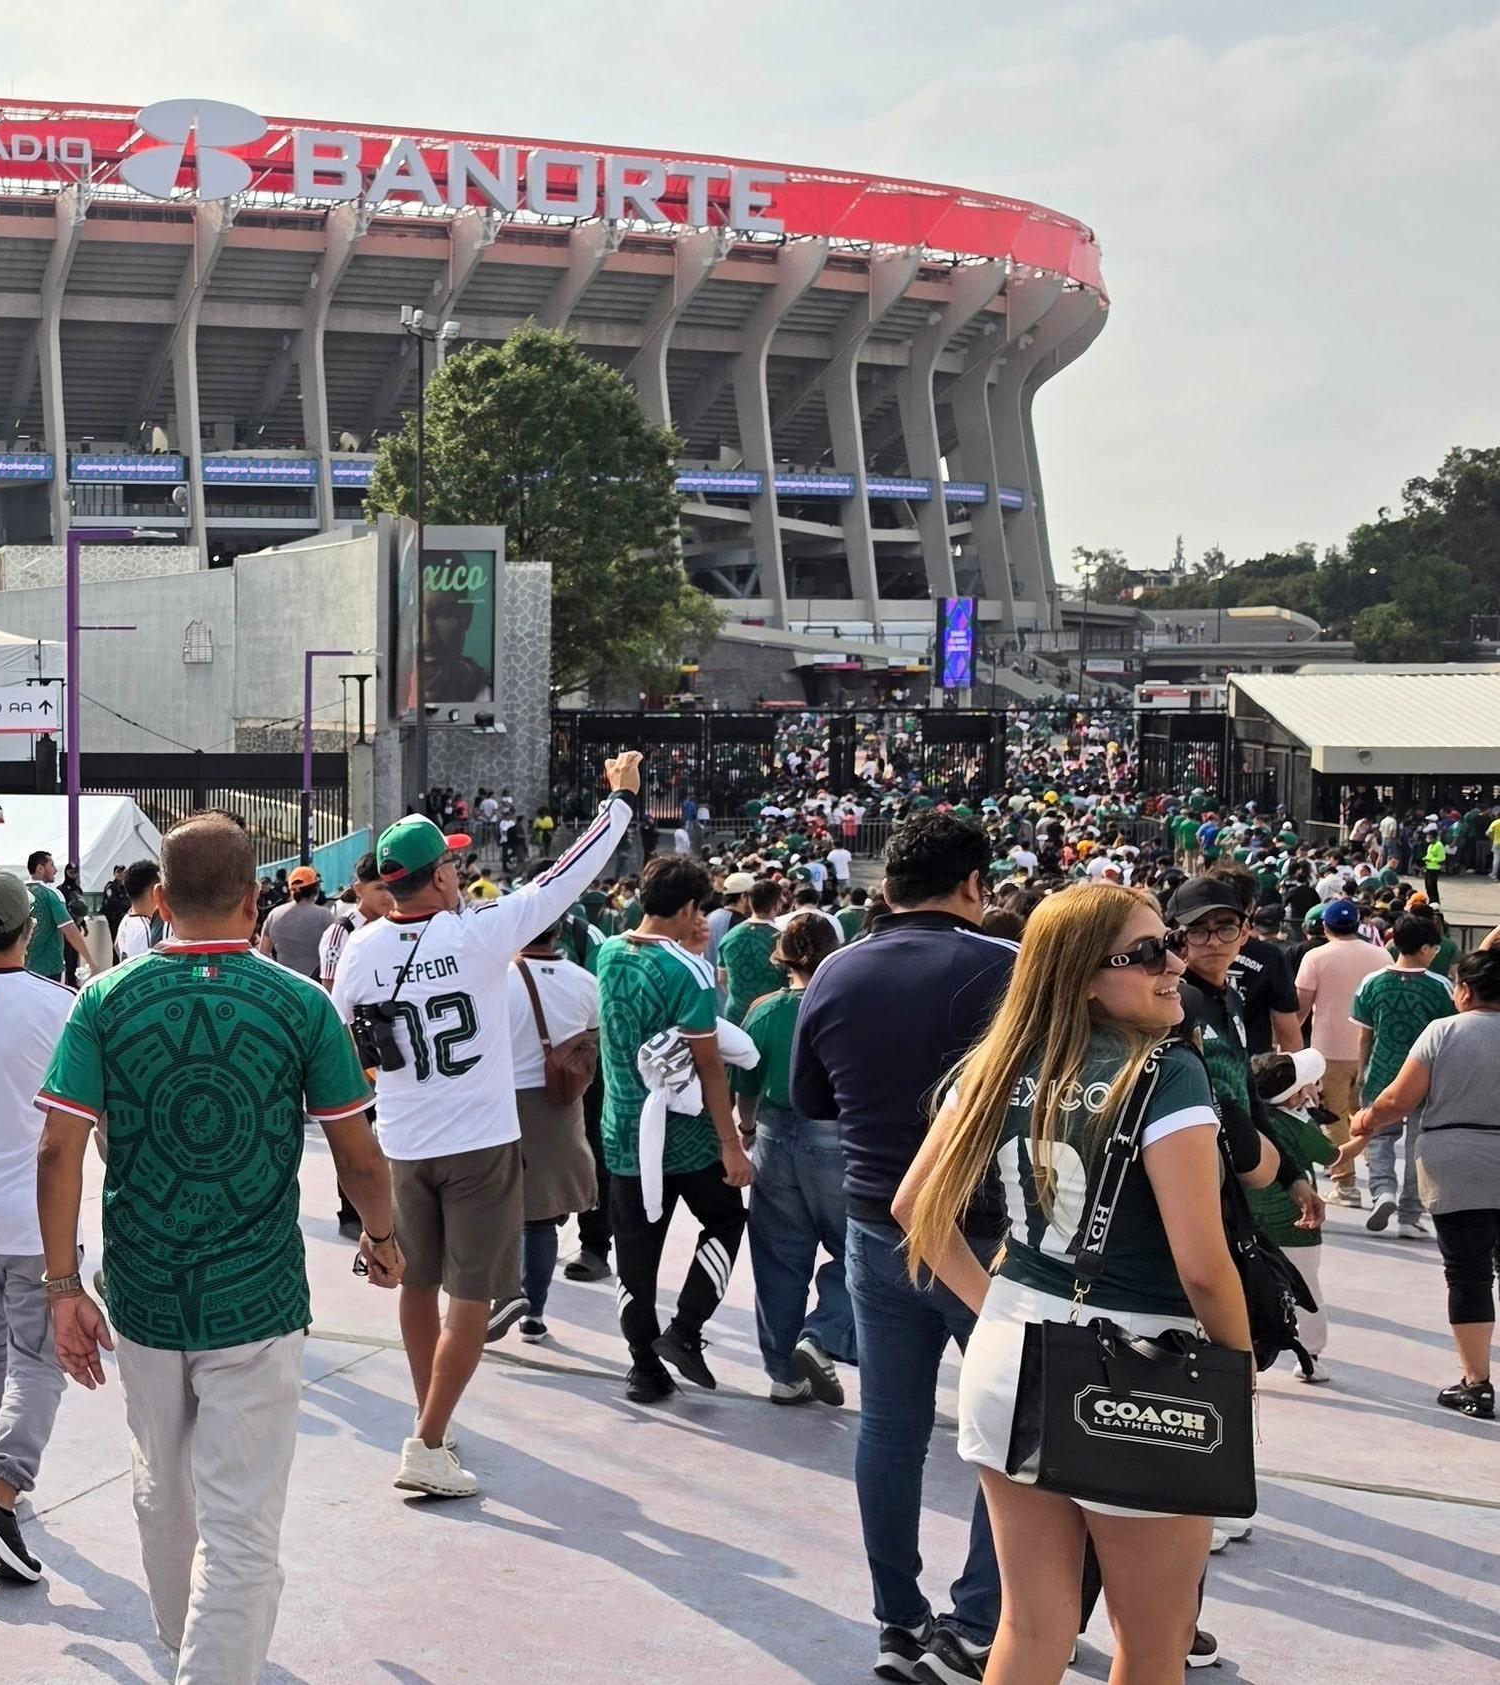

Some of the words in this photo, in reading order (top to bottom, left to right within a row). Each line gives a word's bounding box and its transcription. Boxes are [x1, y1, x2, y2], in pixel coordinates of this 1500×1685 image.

[293, 129, 787, 234] BANORTE
[0, 462, 45, 471] boletos
[333, 468, 373, 477] compr
[423, 558, 488, 591] xico
[9, 702, 33, 713] AA
[374, 969, 389, 987] L.
[393, 955, 459, 985] ZEPEDA
[1008, 1077, 1114, 1114] EXICO
[1094, 1399, 1206, 1431] COACH
[1094, 1416, 1205, 1440] LEATHERWARE
